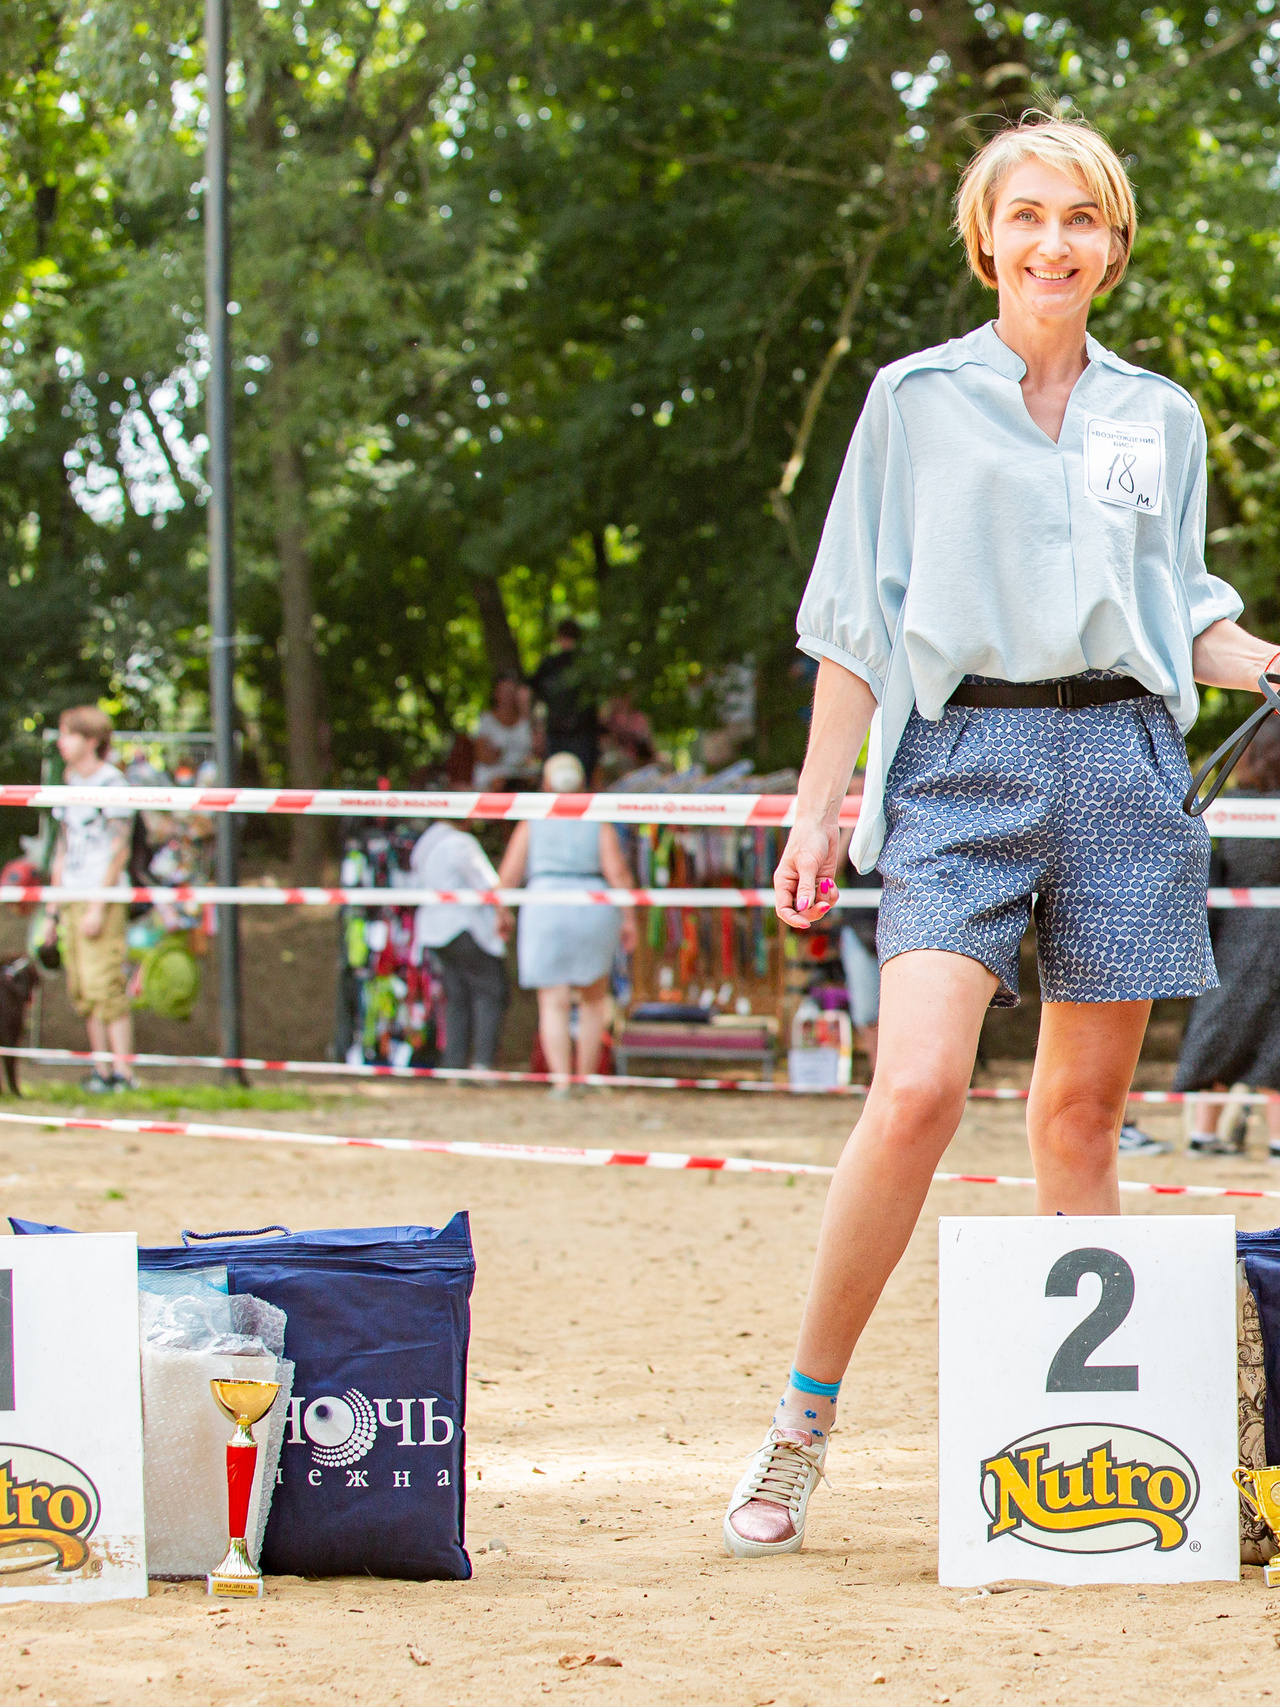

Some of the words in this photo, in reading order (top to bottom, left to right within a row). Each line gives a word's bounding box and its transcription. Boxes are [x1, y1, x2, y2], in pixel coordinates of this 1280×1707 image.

[1106, 453, 1137, 494] 18
[1044, 1246, 1139, 1392] 2
[0, 1461, 90, 1571] tro
[983, 1442, 1189, 1550] Nutro
